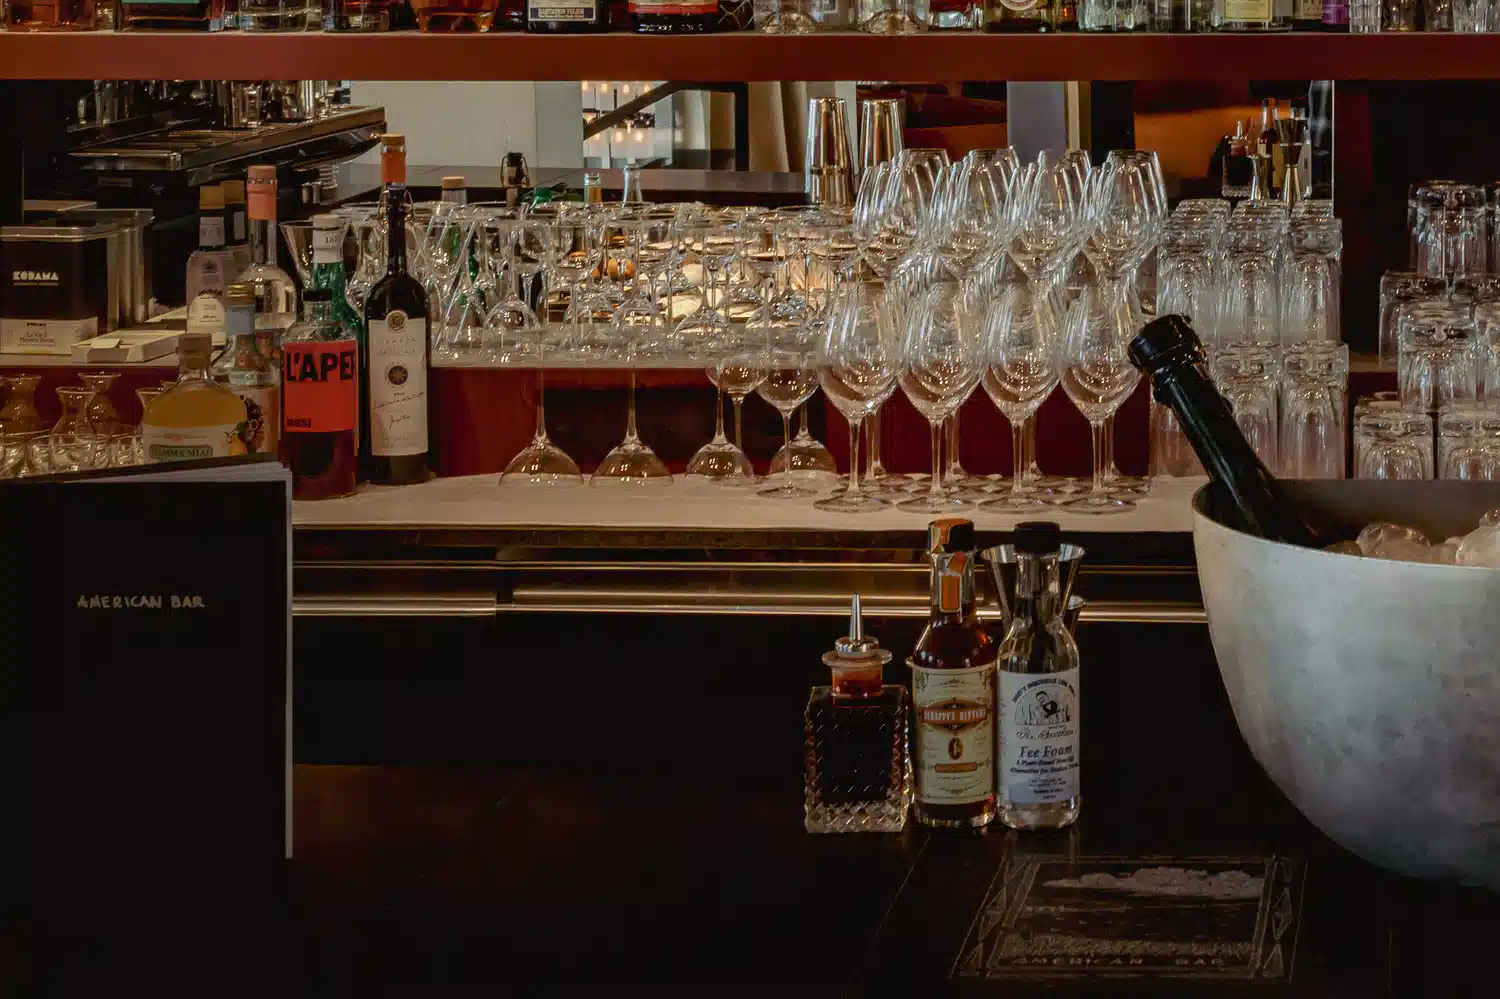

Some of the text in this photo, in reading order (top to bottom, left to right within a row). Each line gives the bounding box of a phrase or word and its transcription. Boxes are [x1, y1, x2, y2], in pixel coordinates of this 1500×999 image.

[13, 270, 61, 281] KODAMA
[76, 594, 208, 609] AMERICAN BAR
[1019, 743, 1073, 758] Fee Foam
